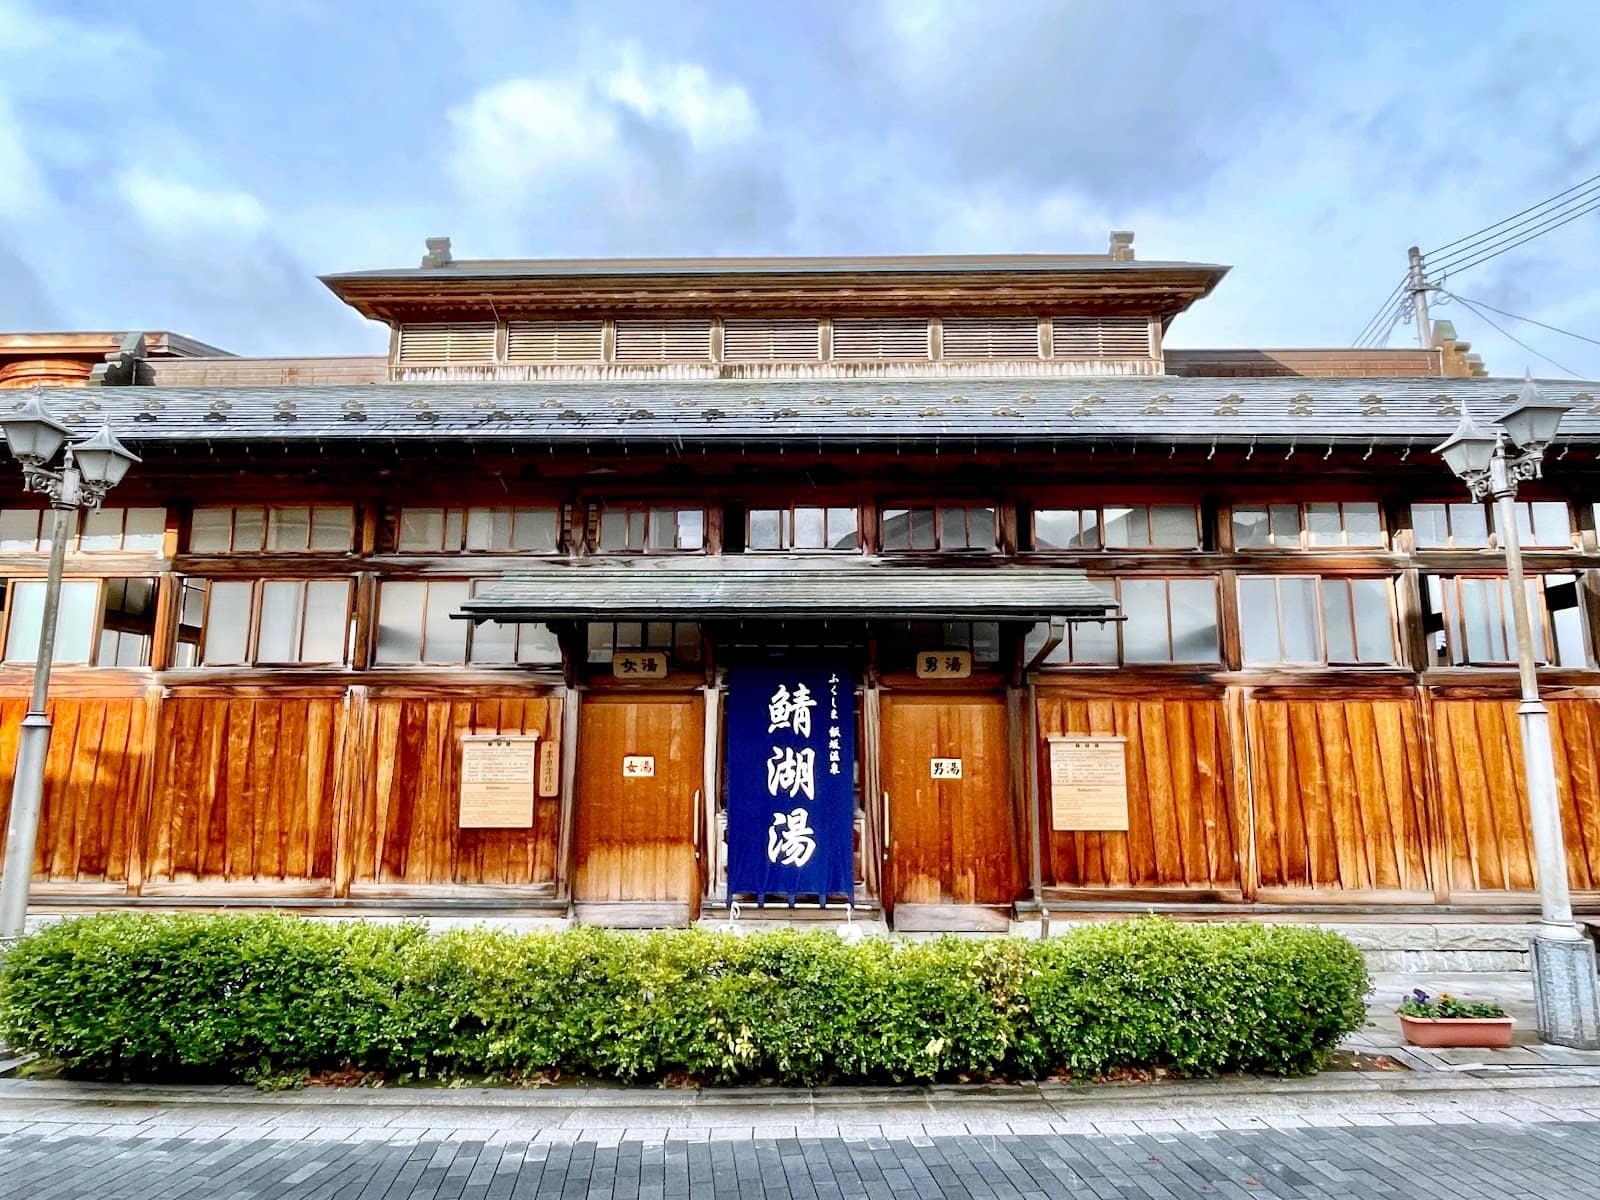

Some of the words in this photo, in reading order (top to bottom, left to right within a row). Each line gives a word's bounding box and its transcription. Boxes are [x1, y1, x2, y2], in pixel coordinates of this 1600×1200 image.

[621, 658, 658, 673] 女湯
[923, 656, 962, 673] 男湯
[828, 673, 840, 720] ふくしま
[625, 760, 652, 773] 女湯
[933, 762, 960, 775] 男湯
[766, 682, 818, 868] 鯖湖湯
